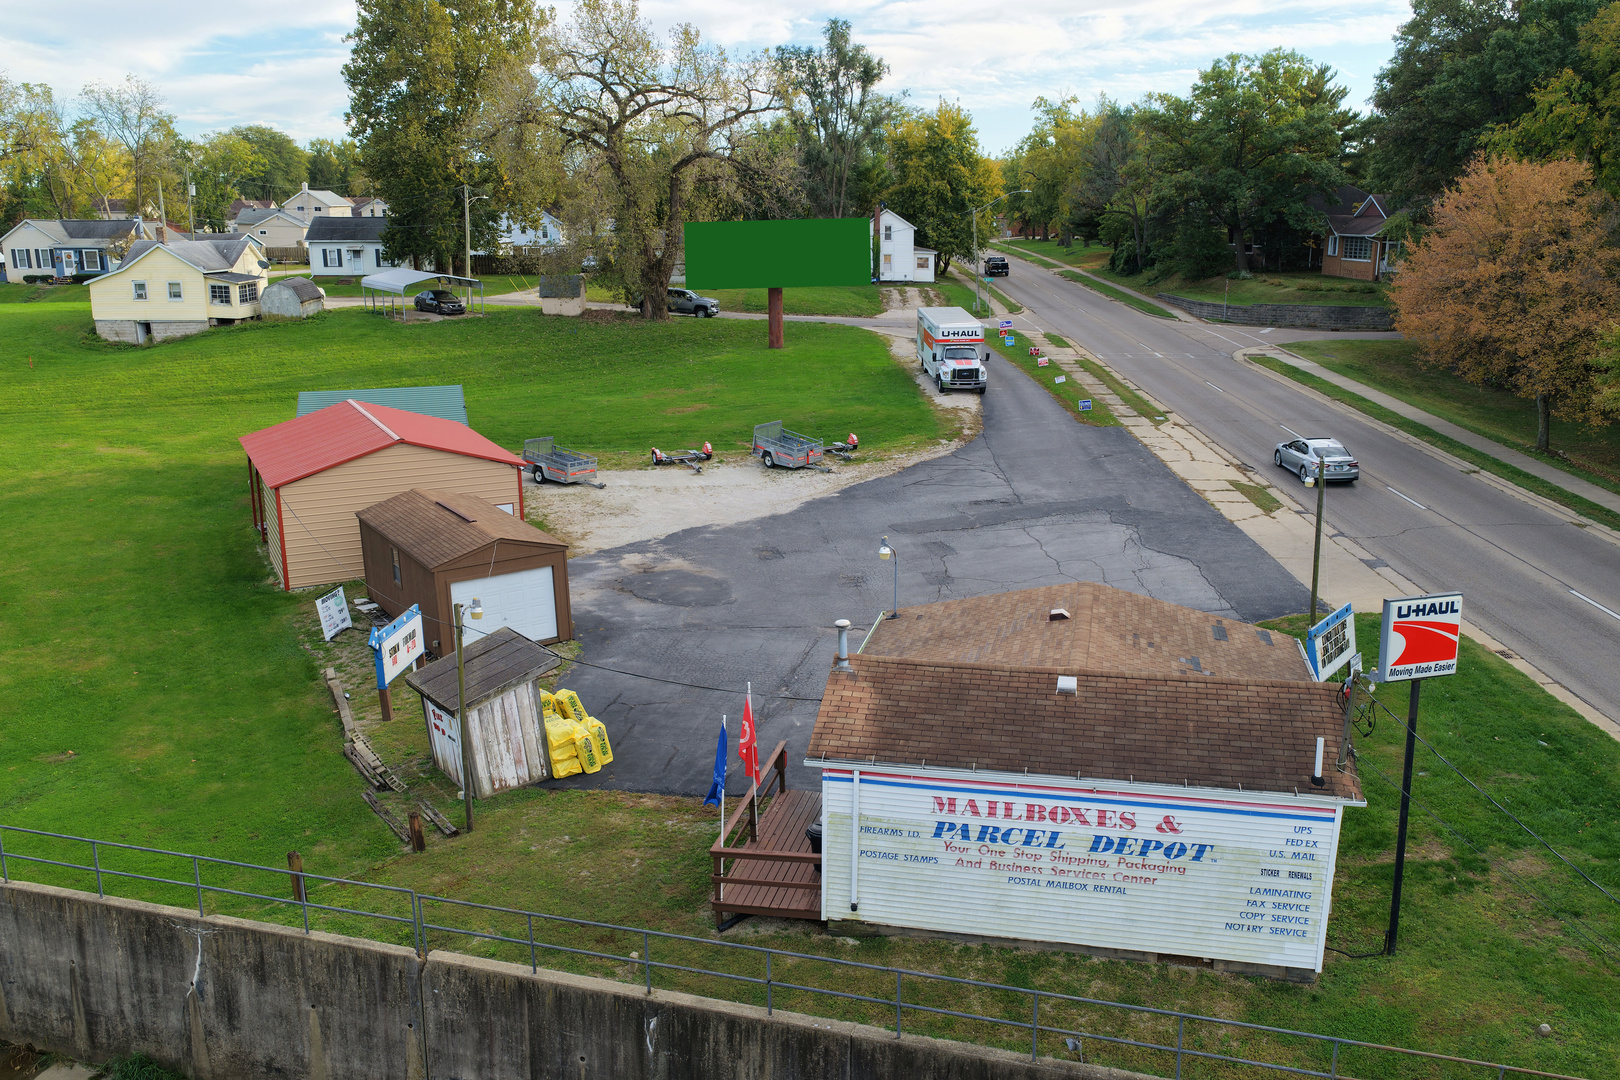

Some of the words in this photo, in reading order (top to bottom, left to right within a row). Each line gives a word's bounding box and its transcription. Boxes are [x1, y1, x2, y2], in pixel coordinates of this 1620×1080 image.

[1397, 601, 1459, 619] U-HAUL
[1389, 667, 1414, 677] Moving
[1414, 664, 1433, 674] Made
[931, 796, 1137, 831] MAILBOXES
[1156, 815, 1184, 834] &
[859, 826, 904, 837] FIREARMS
[907, 830, 921, 838] I.D.
[1293, 826, 1313, 835] UPS
[930, 820, 1067, 849] PARCEL
[1087, 834, 1215, 863] DEPOT
[1285, 838, 1304, 847] FED
[1305, 840, 1318, 848] EX
[859, 850, 899, 861] POSTAGE
[903, 854, 939, 864] STAMPS
[943, 841, 972, 854] Your
[978, 844, 1006, 858] One
[1012, 847, 1043, 862] Stop
[1050, 851, 1110, 869] Shipping,
[1117, 857, 1187, 875] Packaging
[1269, 850, 1286, 859] U.S.
[1291, 852, 1316, 861] MAIL
[954, 857, 982, 869] And
[989, 860, 1043, 875] Business
[1051, 866, 1106, 881] Services
[1112, 871, 1158, 885] Center
[1260, 869, 1280, 877] STICKER
[1288, 871, 1312, 880] RENEWALS
[1007, 876, 1041, 886] POSTAL
[1045, 880, 1089, 891] MAILBOX
[1093, 884, 1127, 895] RENTAL
[1249, 887, 1312, 900] LAMINATING
[1246, 900, 1266, 908] FAX
[1272, 902, 1311, 912] SERVICE
[1239, 911, 1266, 921] COPY
[1271, 914, 1310, 925] SERVICE
[1224, 922, 1264, 933] NOTARY
[1269, 926, 1308, 938] SERVICE
